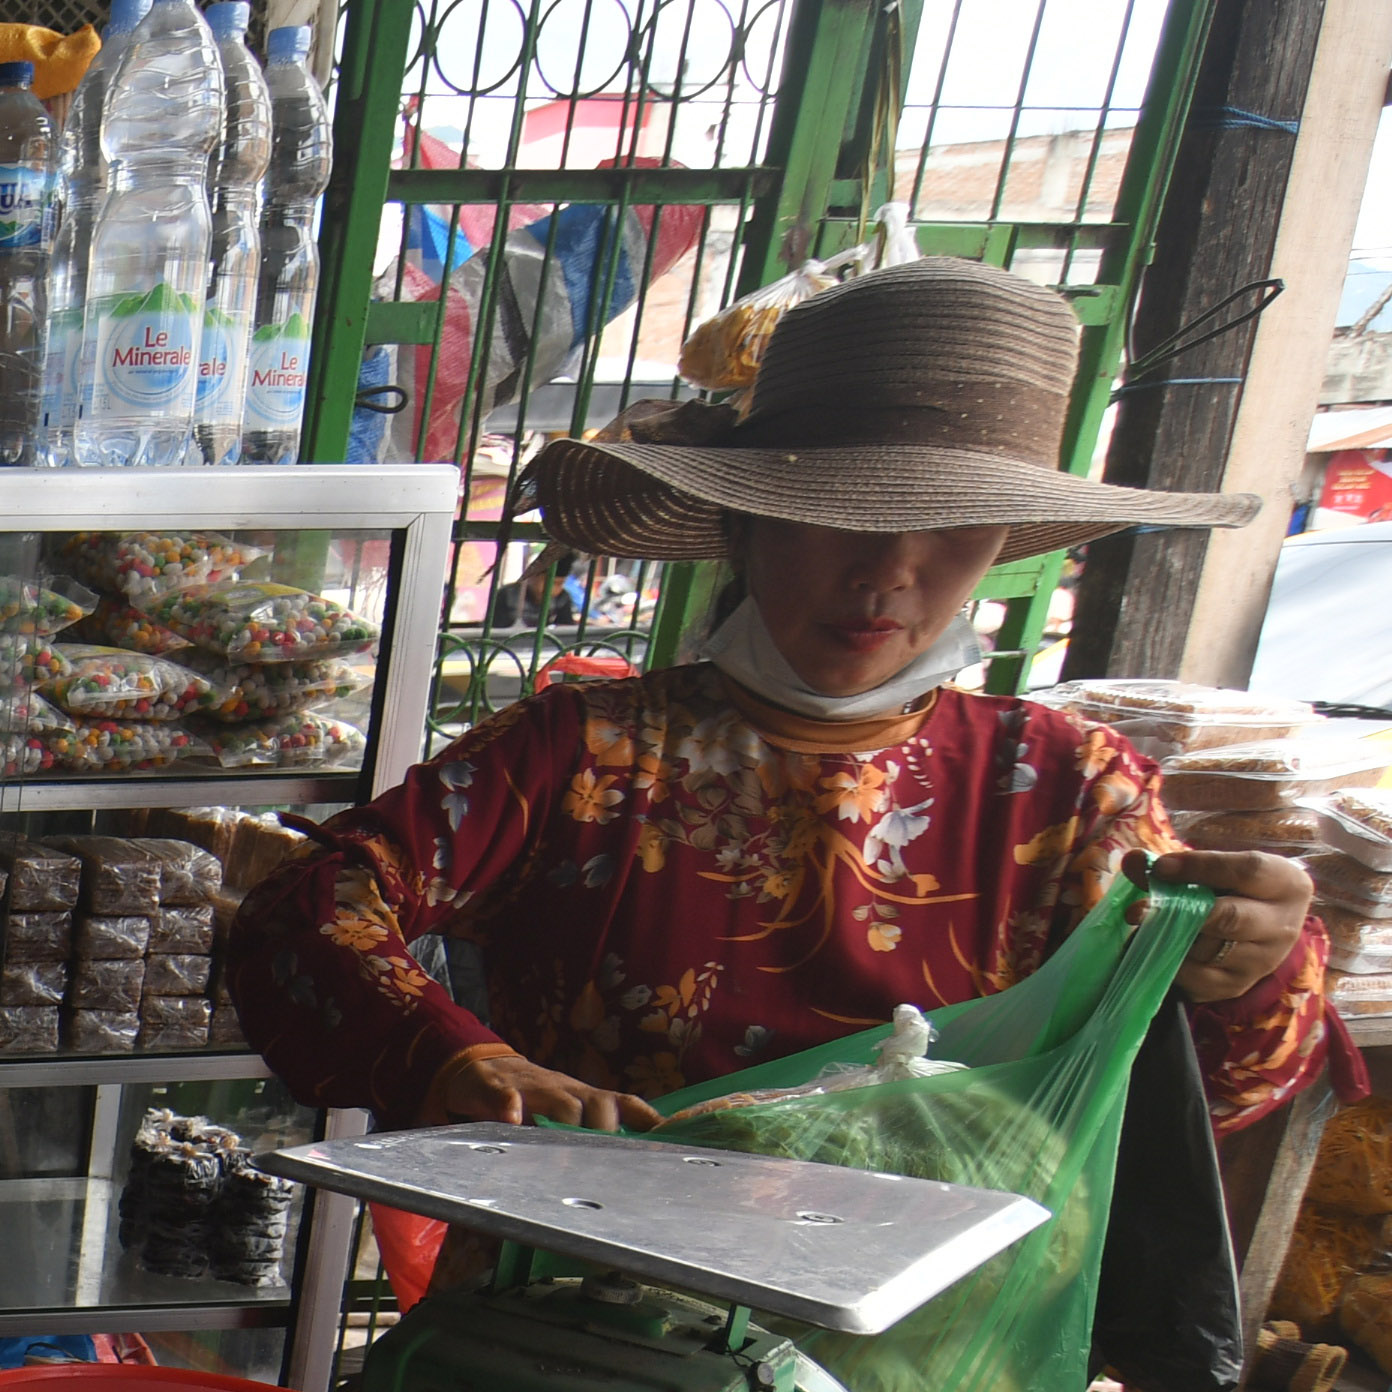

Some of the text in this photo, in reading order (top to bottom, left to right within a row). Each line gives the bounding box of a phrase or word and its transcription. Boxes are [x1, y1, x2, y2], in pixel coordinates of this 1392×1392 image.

[144, 326, 168, 348] Le
[112, 345, 192, 368] Minerale
[280, 351, 299, 371] Le
[251, 367, 305, 388] Minera
